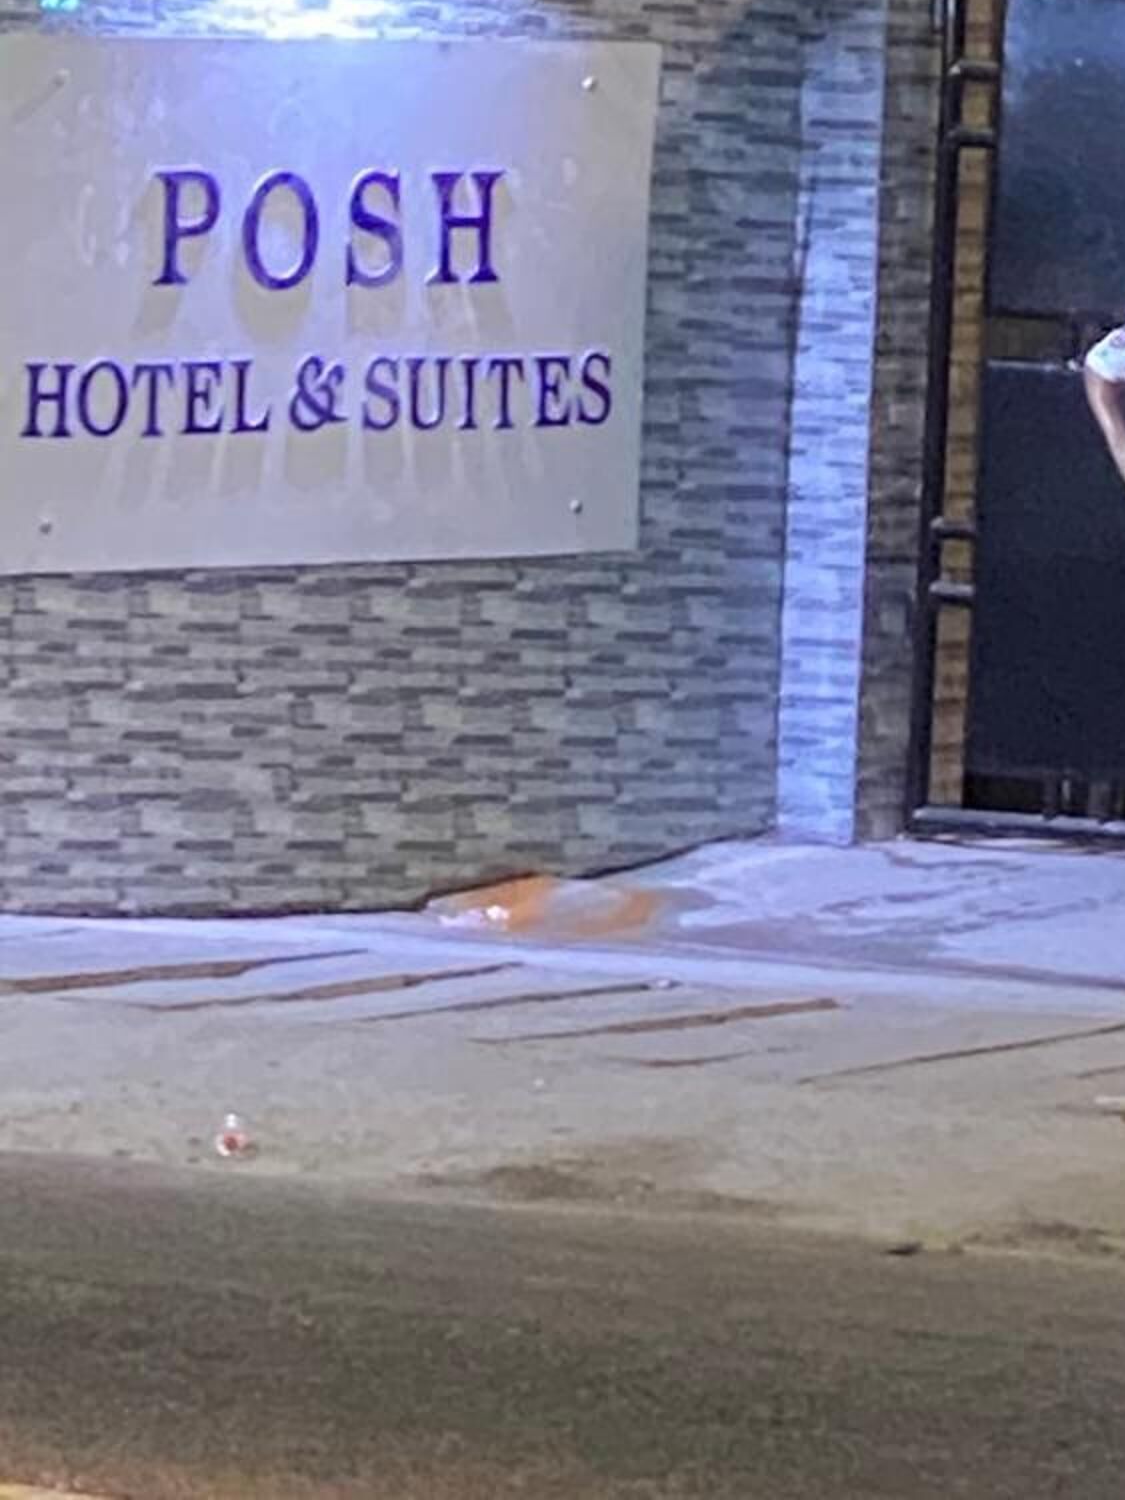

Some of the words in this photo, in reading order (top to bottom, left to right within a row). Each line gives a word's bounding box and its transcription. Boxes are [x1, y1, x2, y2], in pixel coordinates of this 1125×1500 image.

[152, 168, 504, 290] POSH
[20, 357, 271, 438] HOTEL
[288, 355, 348, 432] &
[361, 352, 613, 431] SUITES
